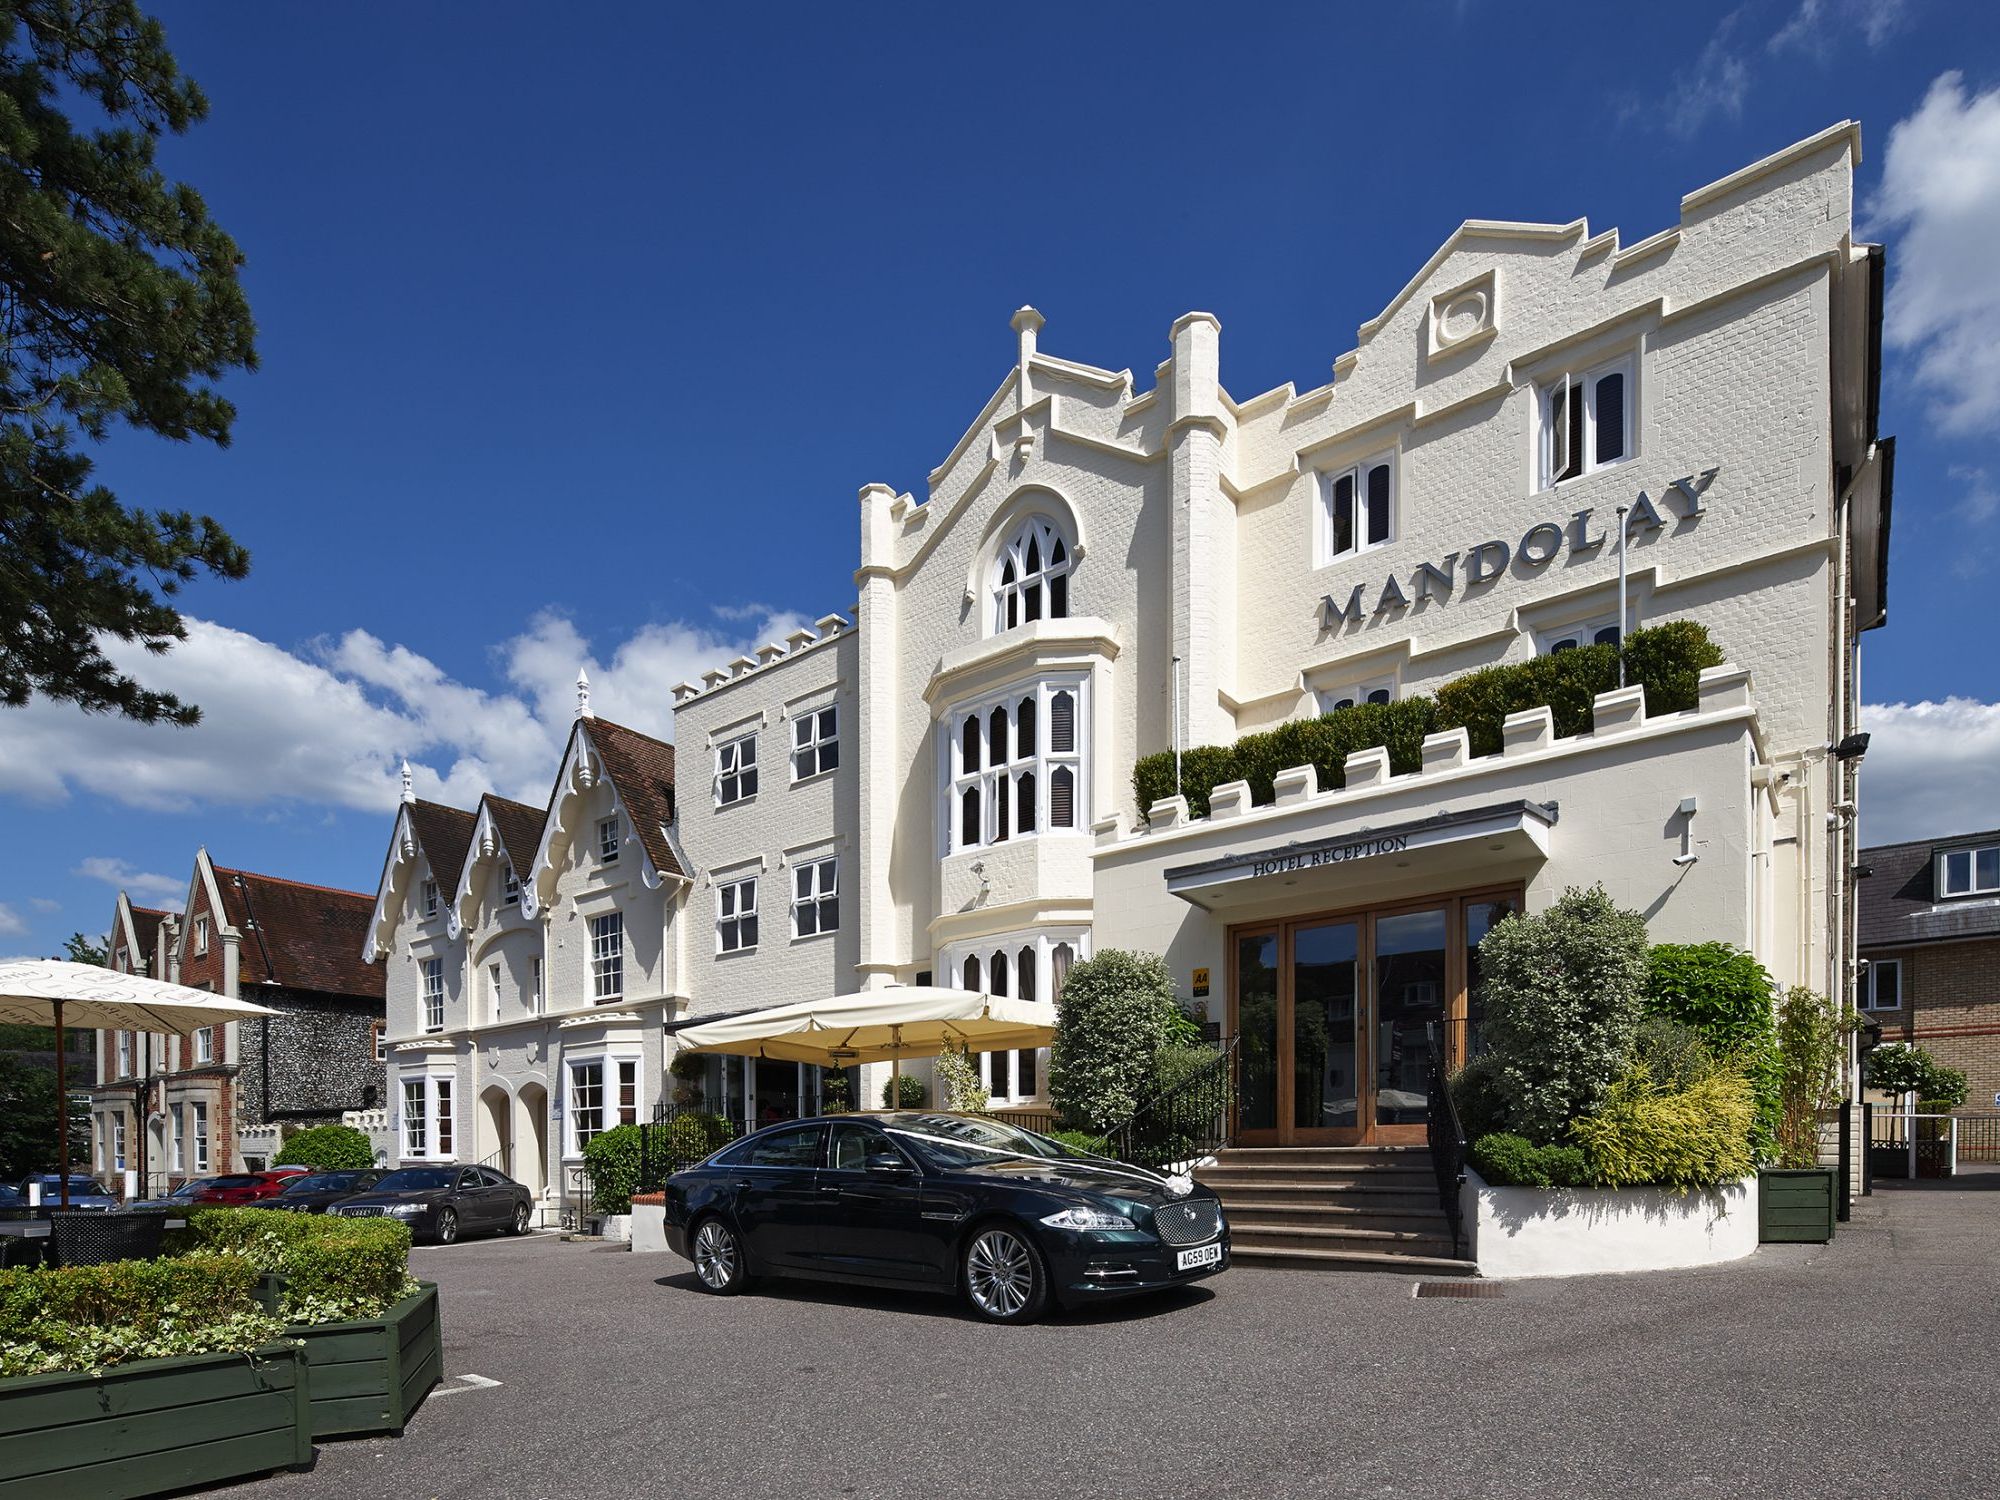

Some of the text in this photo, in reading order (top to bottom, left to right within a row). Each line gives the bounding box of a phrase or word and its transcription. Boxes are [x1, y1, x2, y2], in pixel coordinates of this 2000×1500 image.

[1320, 466, 1720, 631] MANDOLAY
[1253, 835, 1409, 876] HOTEL RECEPTION
[1183, 1250, 1203, 1266] AG59
